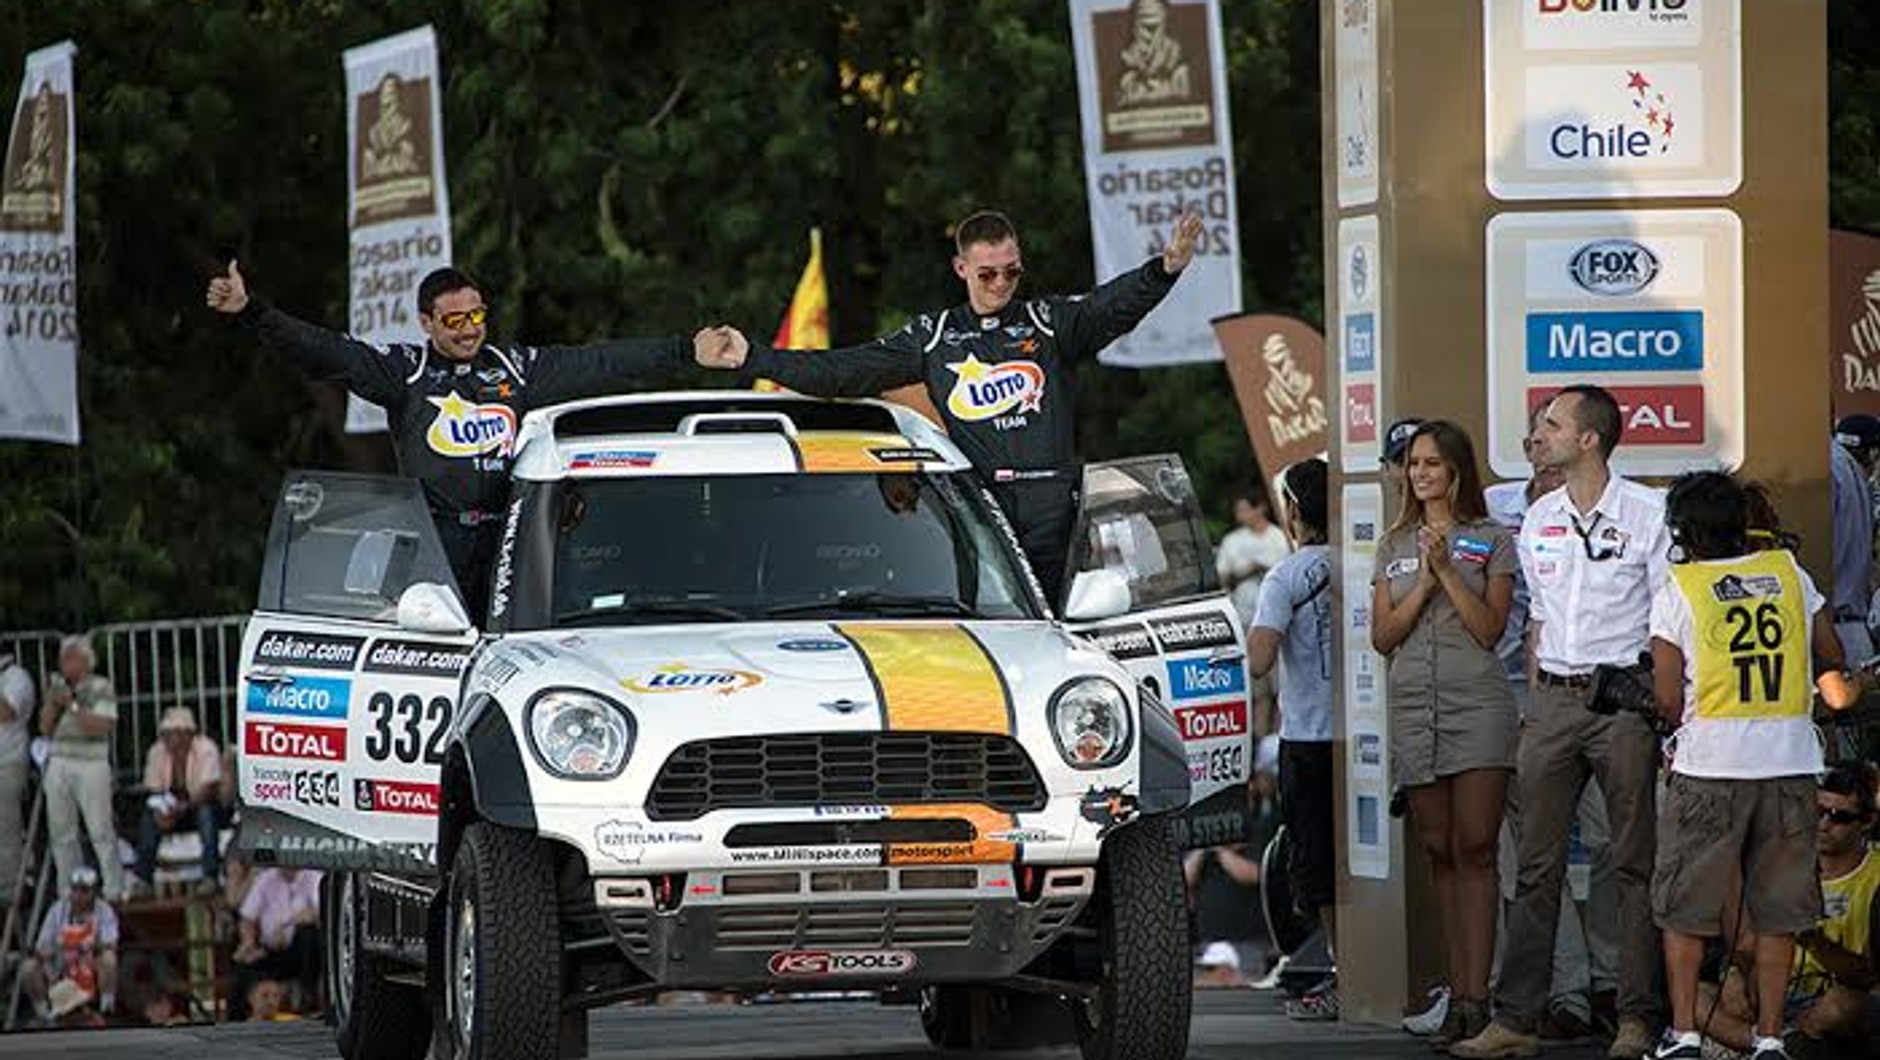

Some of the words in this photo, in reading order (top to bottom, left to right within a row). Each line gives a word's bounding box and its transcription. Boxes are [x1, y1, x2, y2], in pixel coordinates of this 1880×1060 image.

[1550, 124, 1650, 158] Chile
[353, 228, 443, 267] osario
[1589, 251, 1639, 273] FOX
[353, 267, 419, 299] akar
[1588, 272, 1640, 284] SPORTS
[1549, 324, 1681, 358] Macro
[968, 373, 1025, 407] LOTTO
[450, 417, 507, 444] LOTTO
[993, 416, 1028, 430] TEAM
[1158, 622, 1231, 643] dakar.com
[1725, 603, 1783, 653] 26
[259, 635, 355, 662] dakar.com
[371, 644, 466, 670] dakar.com
[648, 673, 736, 688] LOTTO
[1183, 665, 1232, 691] Macro
[1733, 653, 1785, 703] TV
[265, 681, 330, 710] Macro
[365, 691, 453, 766] 332
[1181, 710, 1242, 736] TOTAL
[255, 725, 338, 757] TOTAL
[254, 782, 292, 801] sport
[376, 786, 439, 810] TOTAL
[377, 841, 438, 874] STEY
[891, 844, 974, 859] motorsport
[830, 954, 905, 968] TOOLS
